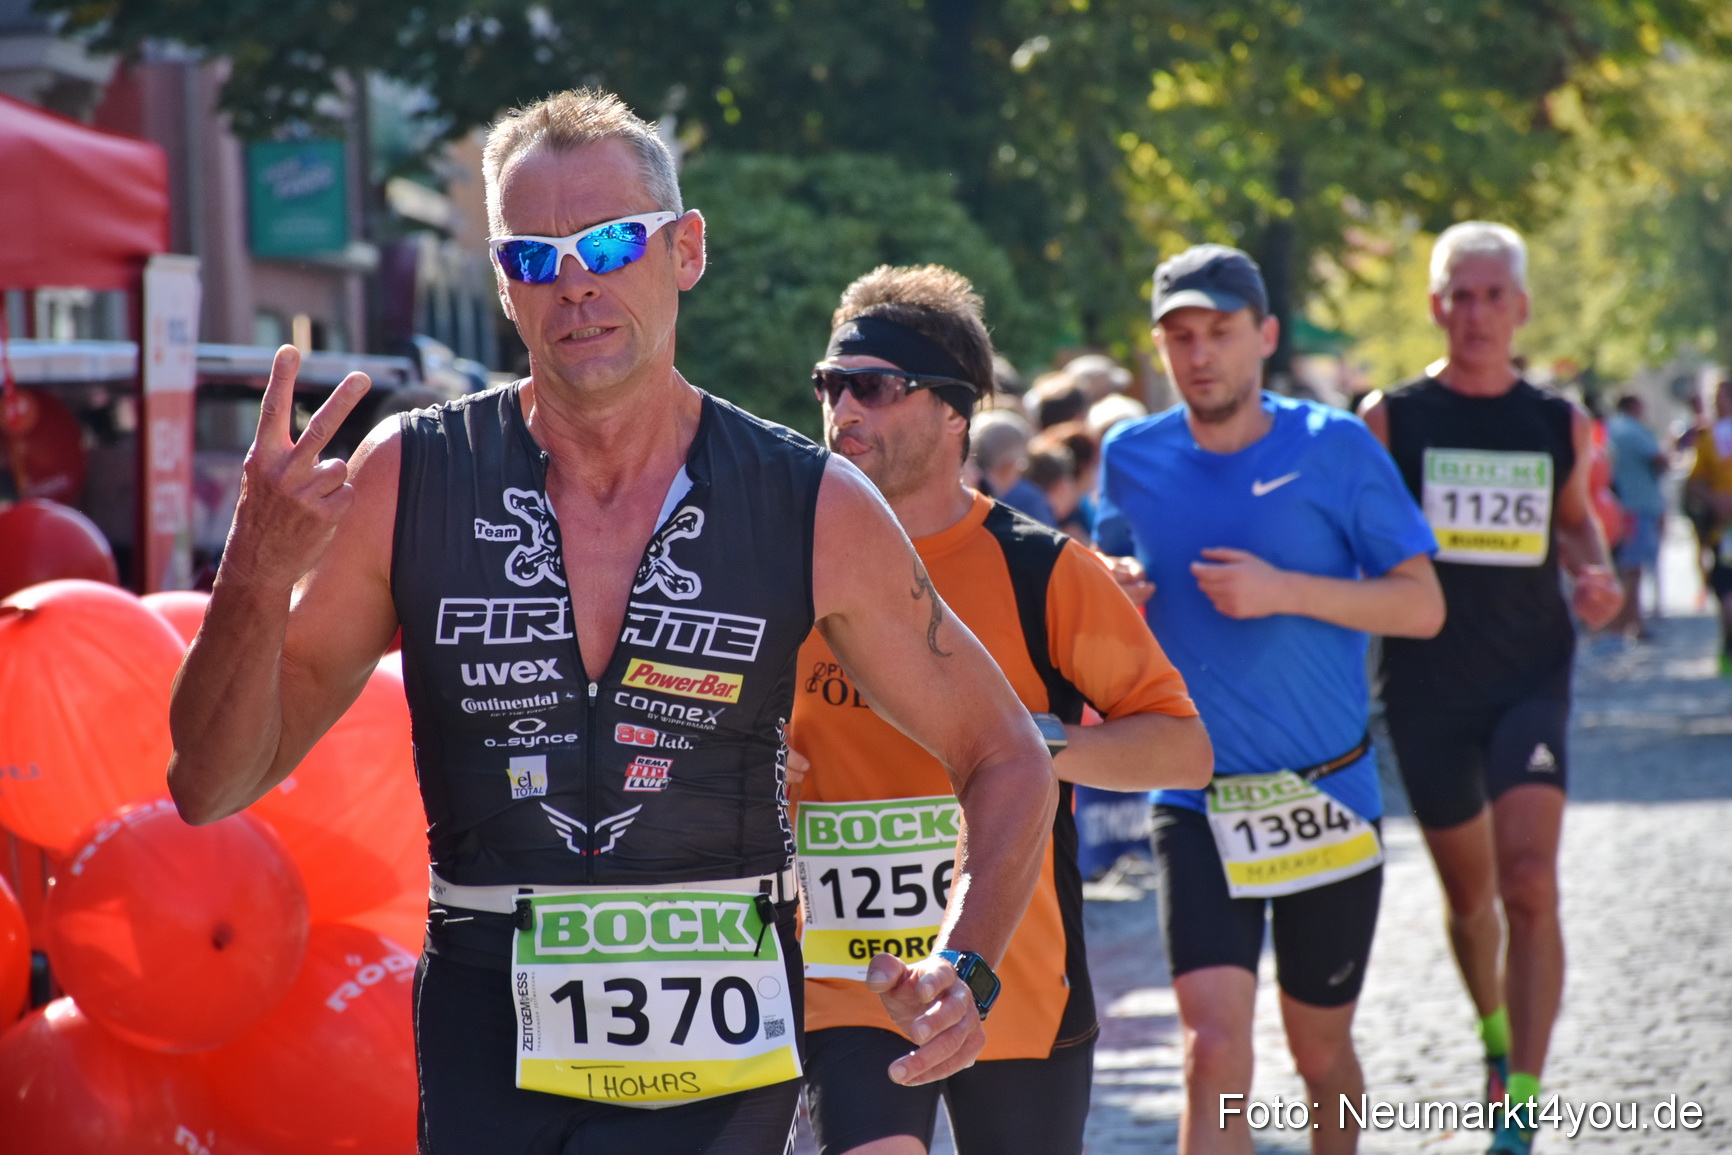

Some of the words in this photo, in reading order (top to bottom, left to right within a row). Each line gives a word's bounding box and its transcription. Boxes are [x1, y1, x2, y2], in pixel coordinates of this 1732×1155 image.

[1443, 490, 1534, 526] 1126
[475, 522, 518, 539] Team
[461, 658, 563, 686] uvex
[461, 691, 559, 714] Continental
[614, 691, 727, 725] connex
[484, 733, 579, 749] o_synce
[628, 765, 666, 778] TIP
[636, 757, 669, 768] REMA
[505, 767, 545, 789] Velo
[630, 777, 671, 790] TOP
[513, 786, 544, 798] TOTAL
[808, 808, 960, 847] BOCK
[1234, 802, 1350, 853] 1384
[538, 904, 754, 952] BOCK
[550, 976, 760, 1046] 1370
[571, 1065, 702, 1099] THOMAS
